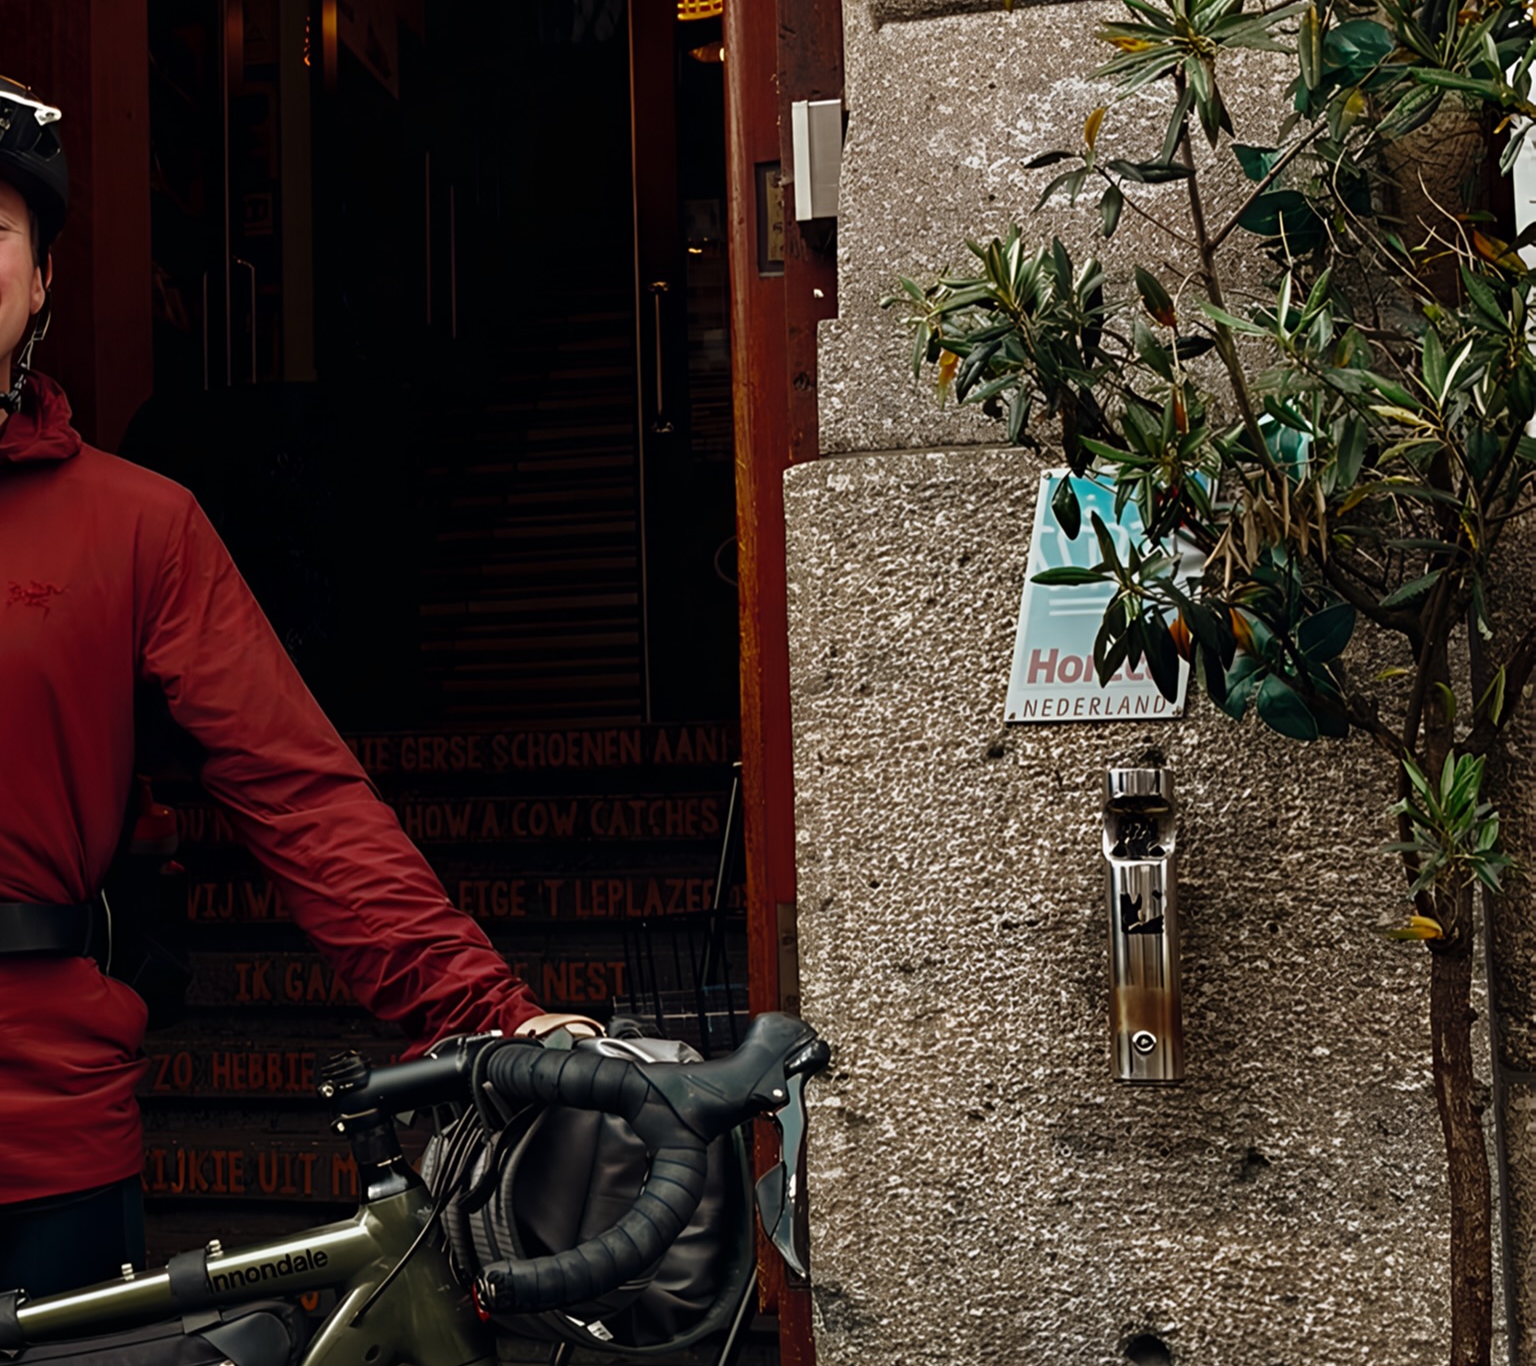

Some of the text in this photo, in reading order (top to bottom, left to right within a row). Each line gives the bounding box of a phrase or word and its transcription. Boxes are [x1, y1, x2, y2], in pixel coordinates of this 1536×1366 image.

[1023, 694, 1166, 718] NEDERLAND
[400, 733, 483, 772] GERSE
[490, 728, 642, 770] SCHOENEN
[515, 797, 578, 836] COW
[590, 795, 720, 834] CATCHES
[233, 959, 272, 1003] IK
[284, 961, 352, 1003] GAA
[541, 960, 626, 1005] NEST
[212, 1050, 317, 1093] HEBBIE
[257, 1151, 318, 1196] UIT
[211, 1249, 328, 1293] nnondale
